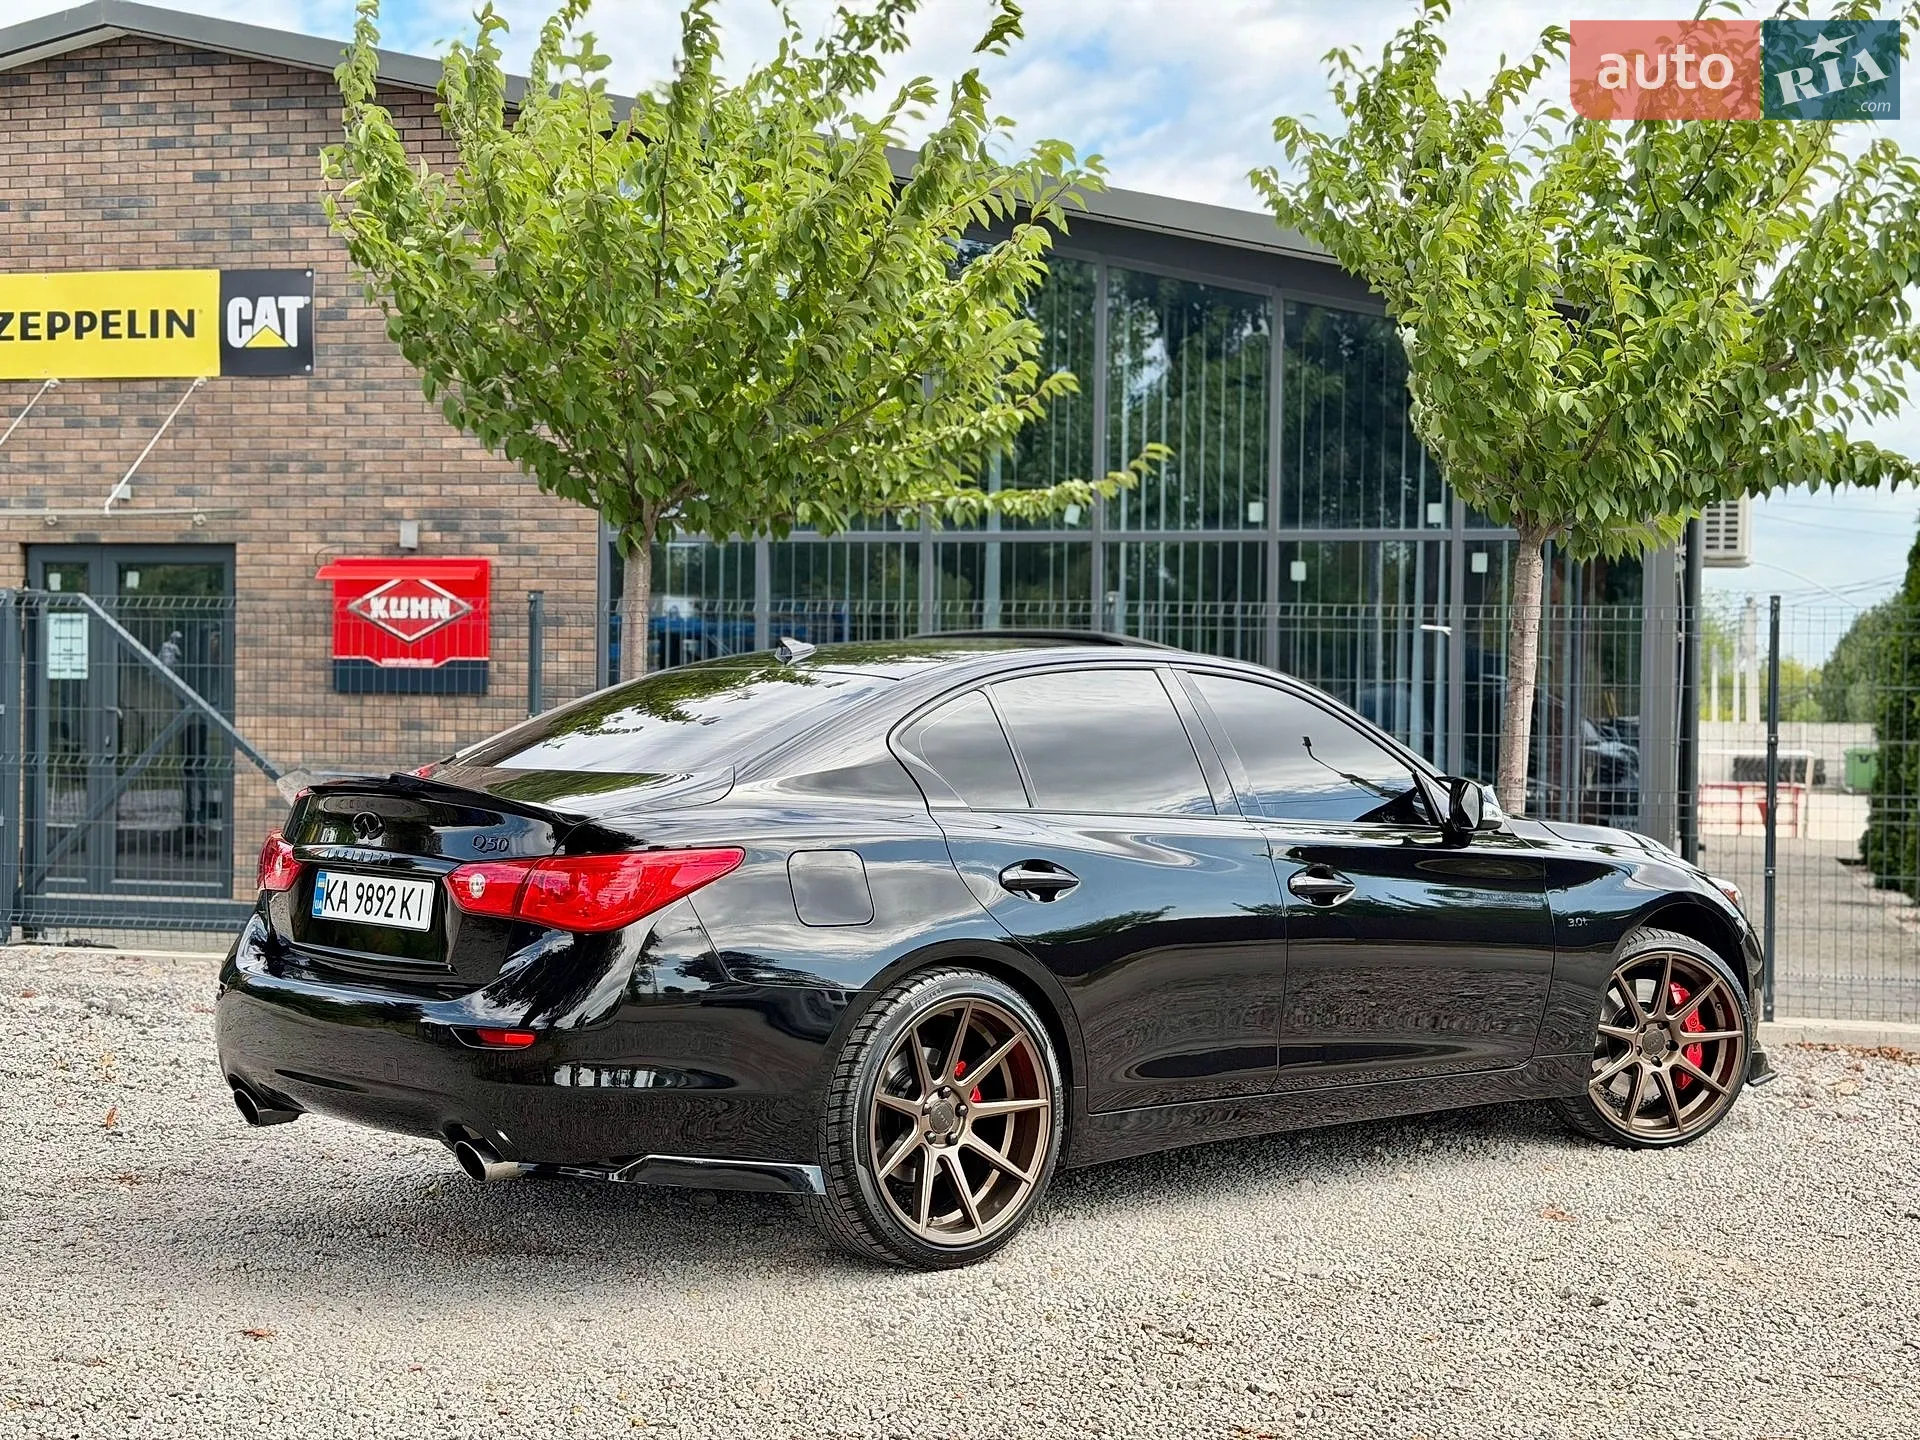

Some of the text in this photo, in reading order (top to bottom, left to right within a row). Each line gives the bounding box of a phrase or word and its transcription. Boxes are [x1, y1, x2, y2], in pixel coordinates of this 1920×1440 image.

[0, 308, 195, 341] ZEPPELIN
[226, 295, 305, 349] CAT
[369, 596, 451, 620] KUHN
[472, 834, 510, 854] Q50
[323, 878, 425, 922] KA 9892 KI
